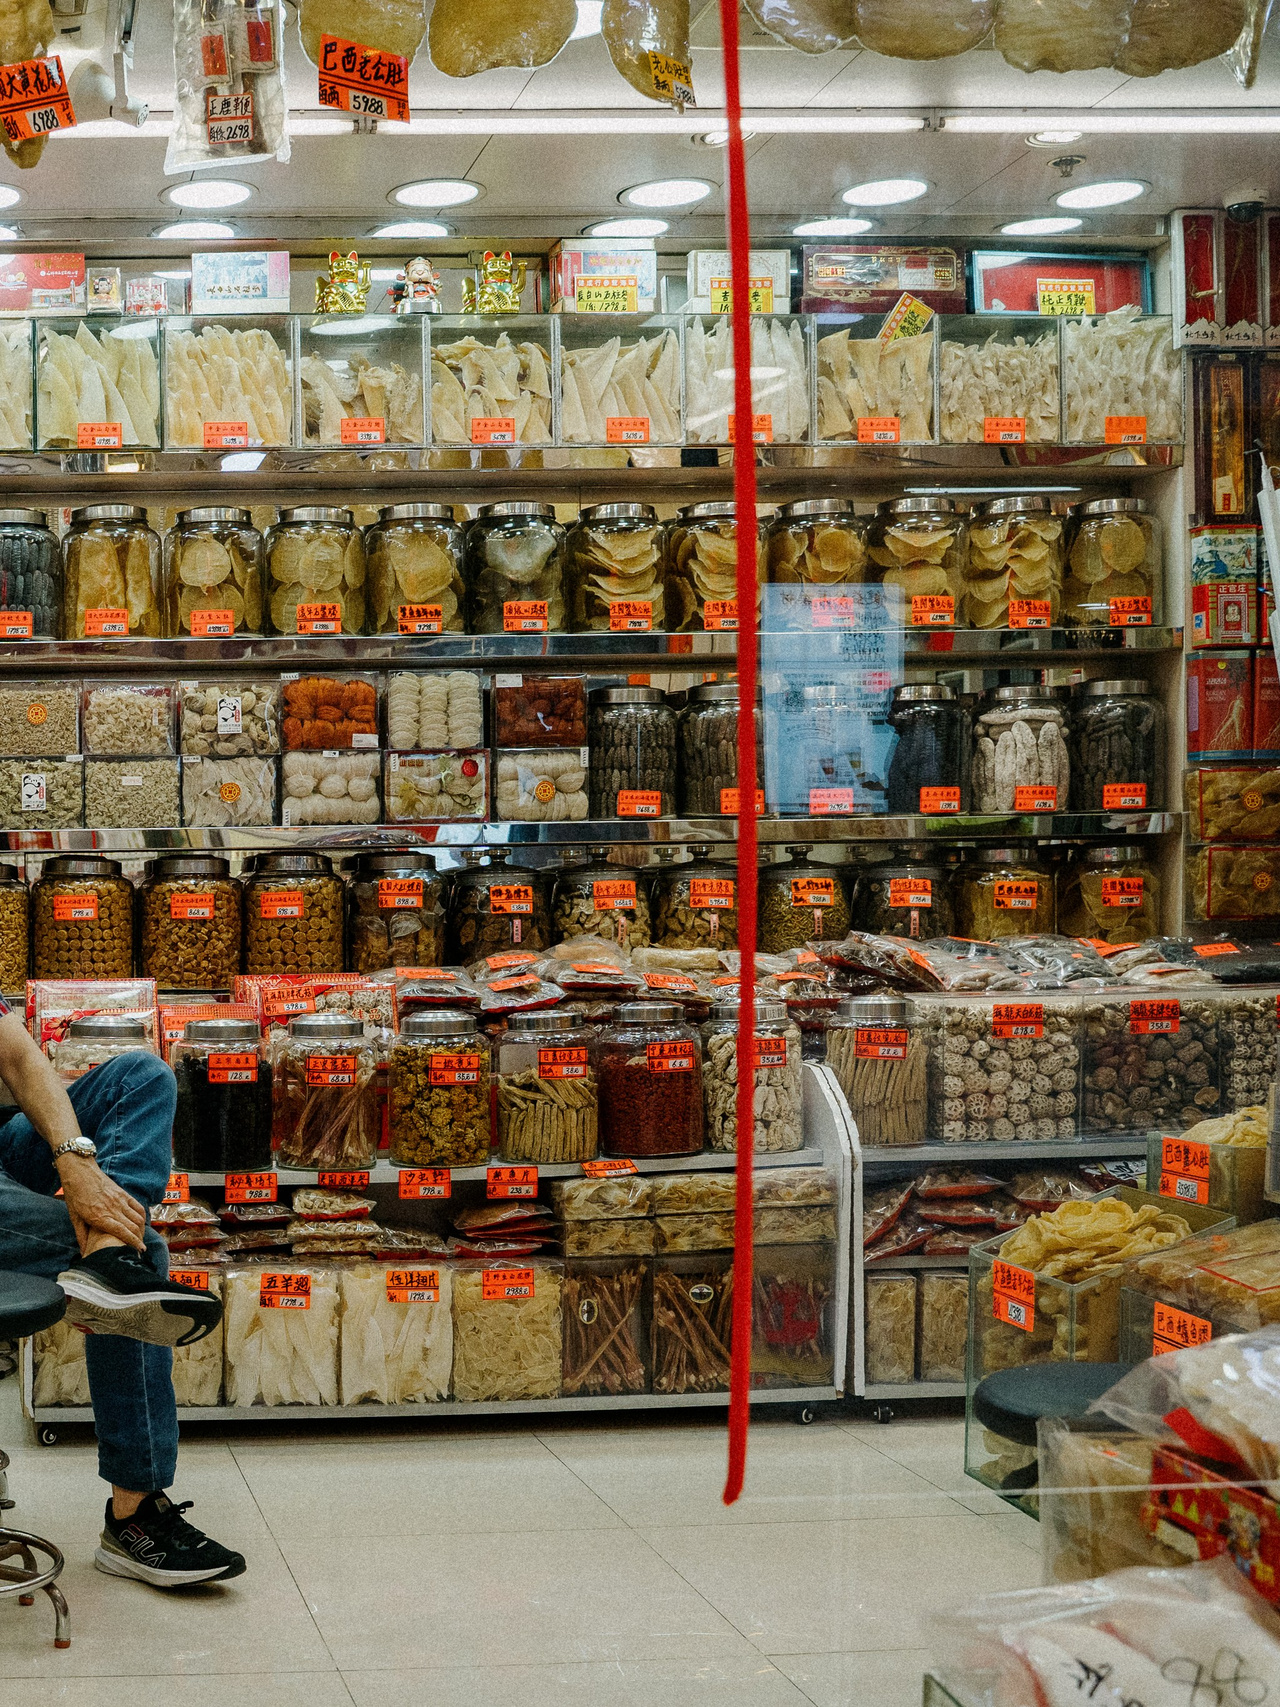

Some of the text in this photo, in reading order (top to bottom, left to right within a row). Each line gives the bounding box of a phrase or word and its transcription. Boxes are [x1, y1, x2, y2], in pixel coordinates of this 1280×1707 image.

[1219, 584, 1247, 594] 正官庄
[120, 1524, 167, 1568] FILA
